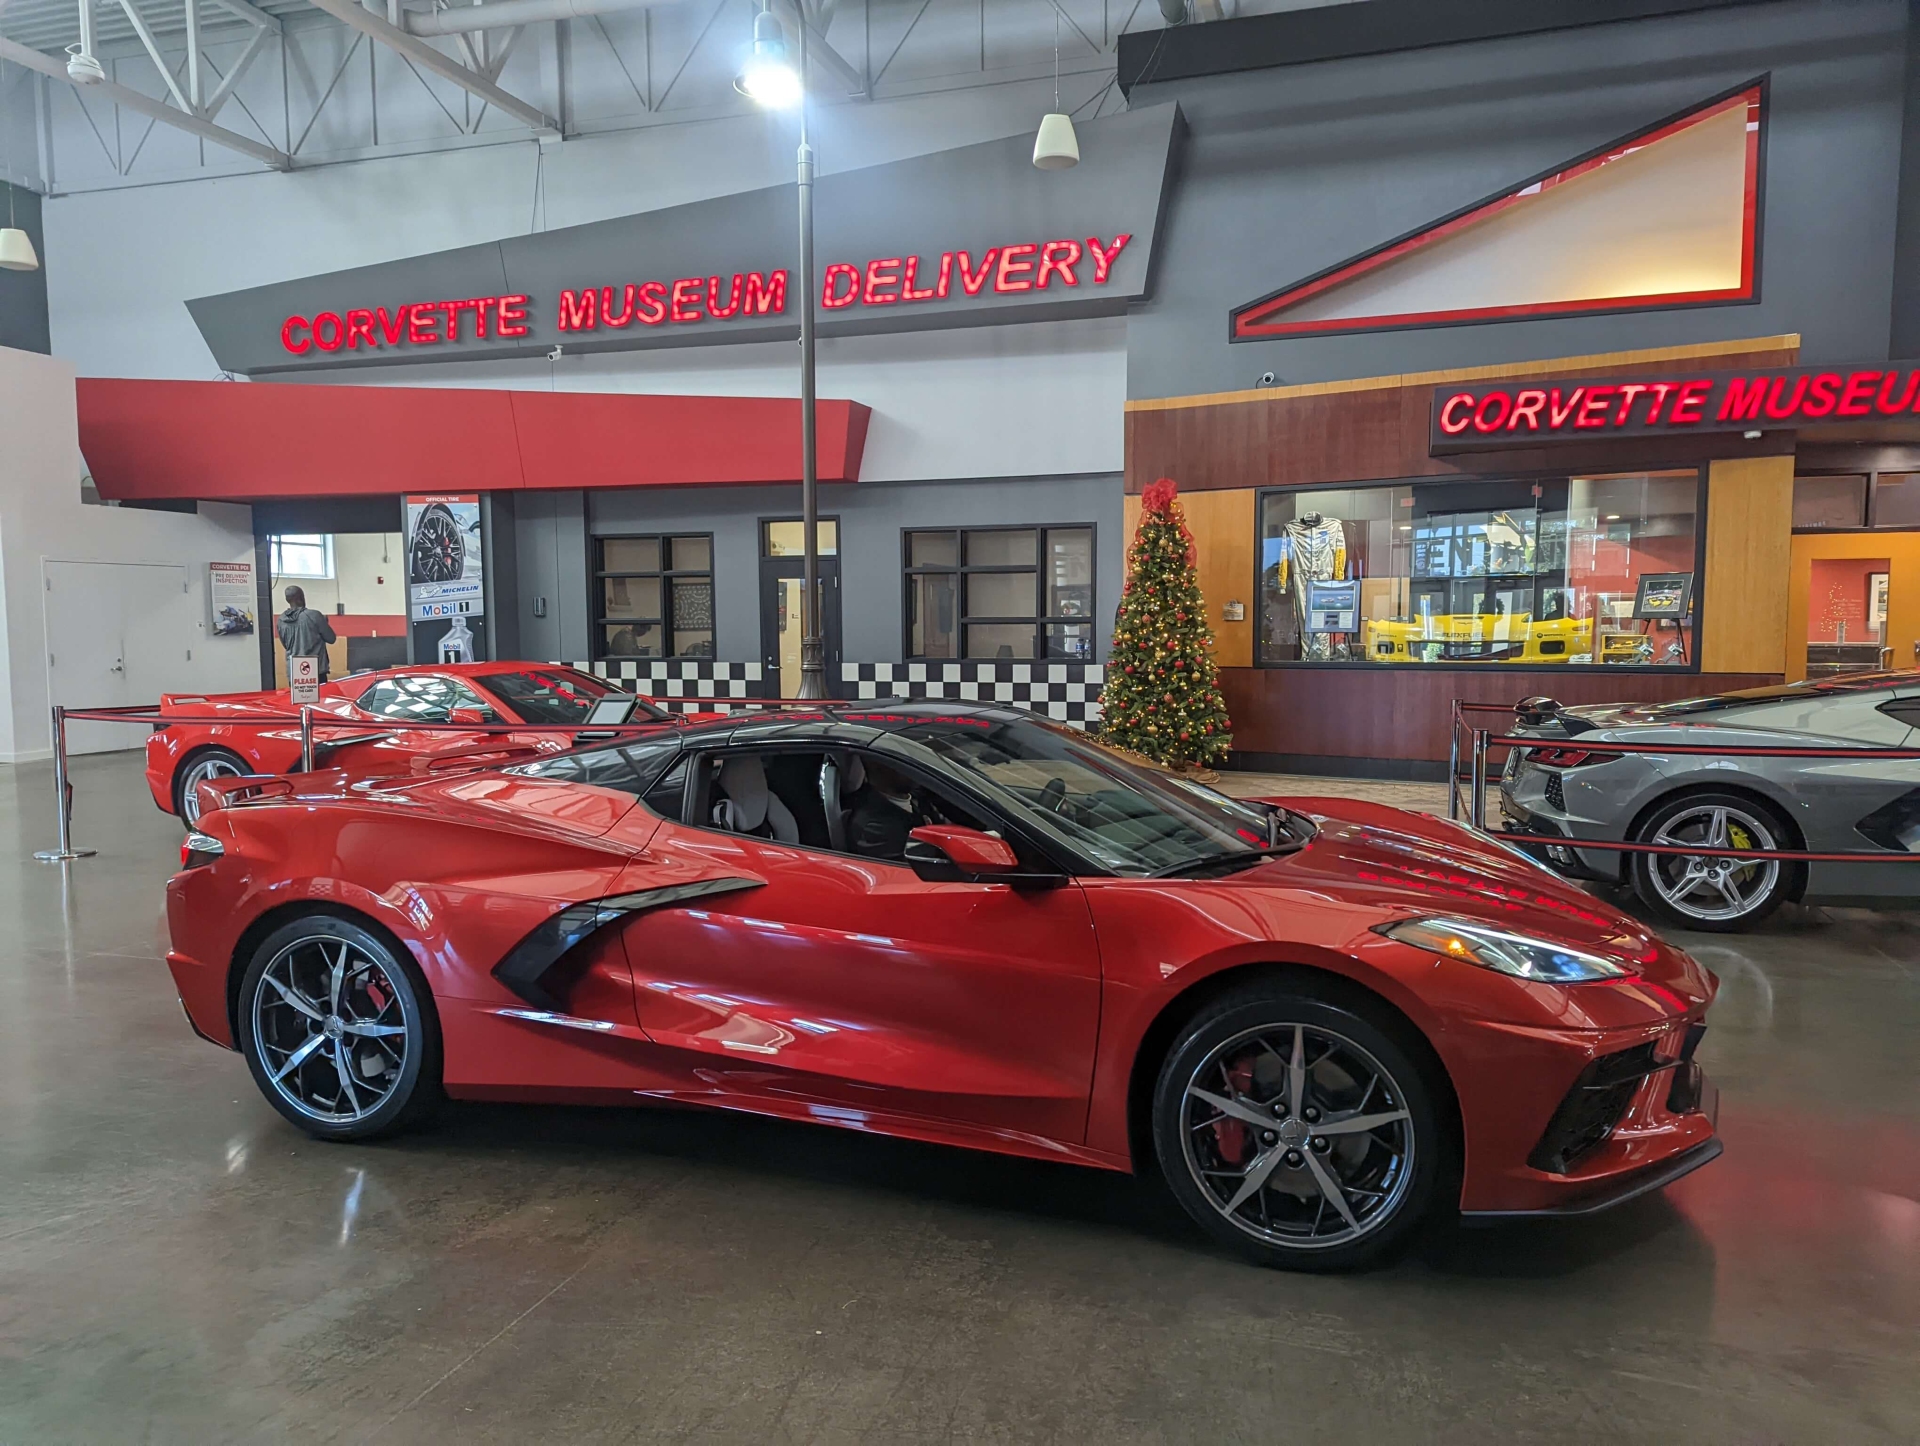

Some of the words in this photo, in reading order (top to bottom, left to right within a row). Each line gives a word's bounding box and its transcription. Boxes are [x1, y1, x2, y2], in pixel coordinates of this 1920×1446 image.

[280, 294, 528, 354] CORVETTE
[557, 269, 788, 332] MUSEUM
[821, 233, 1132, 309] DELIVERY
[1438, 378, 1713, 435] CORVETTE
[1717, 368, 1920, 421] MUSEU
[422, 602, 456, 617] Mobil
[460, 602, 468, 612] 1
[441, 585, 479, 594] MICHELIN
